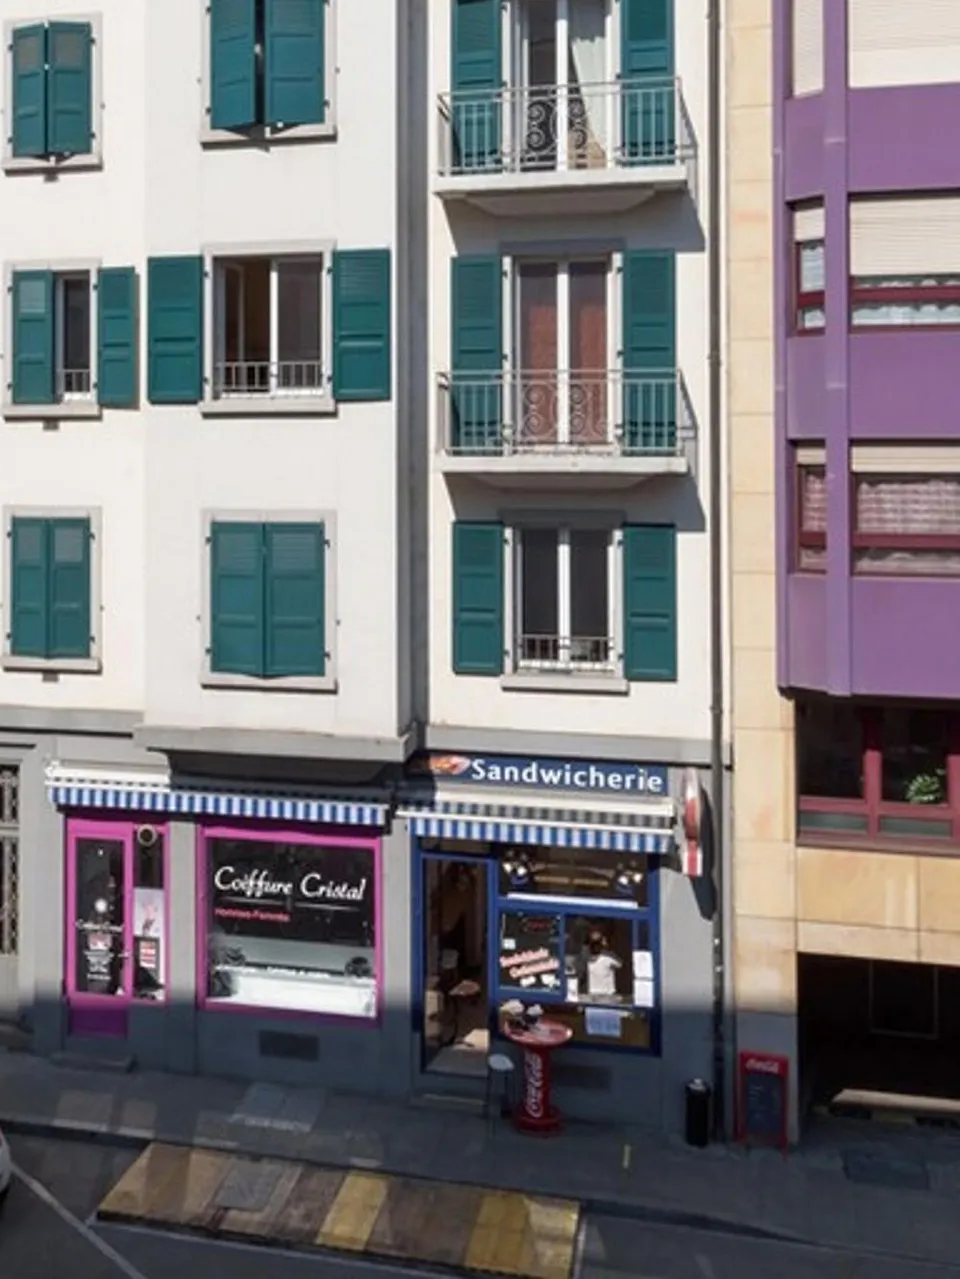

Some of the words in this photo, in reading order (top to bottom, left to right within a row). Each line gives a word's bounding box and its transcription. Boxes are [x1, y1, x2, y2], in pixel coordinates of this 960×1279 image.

[470, 758, 664, 793] Sandwicherie
[214, 865, 293, 898] Coiffure
[299, 872, 367, 901] Cristal
